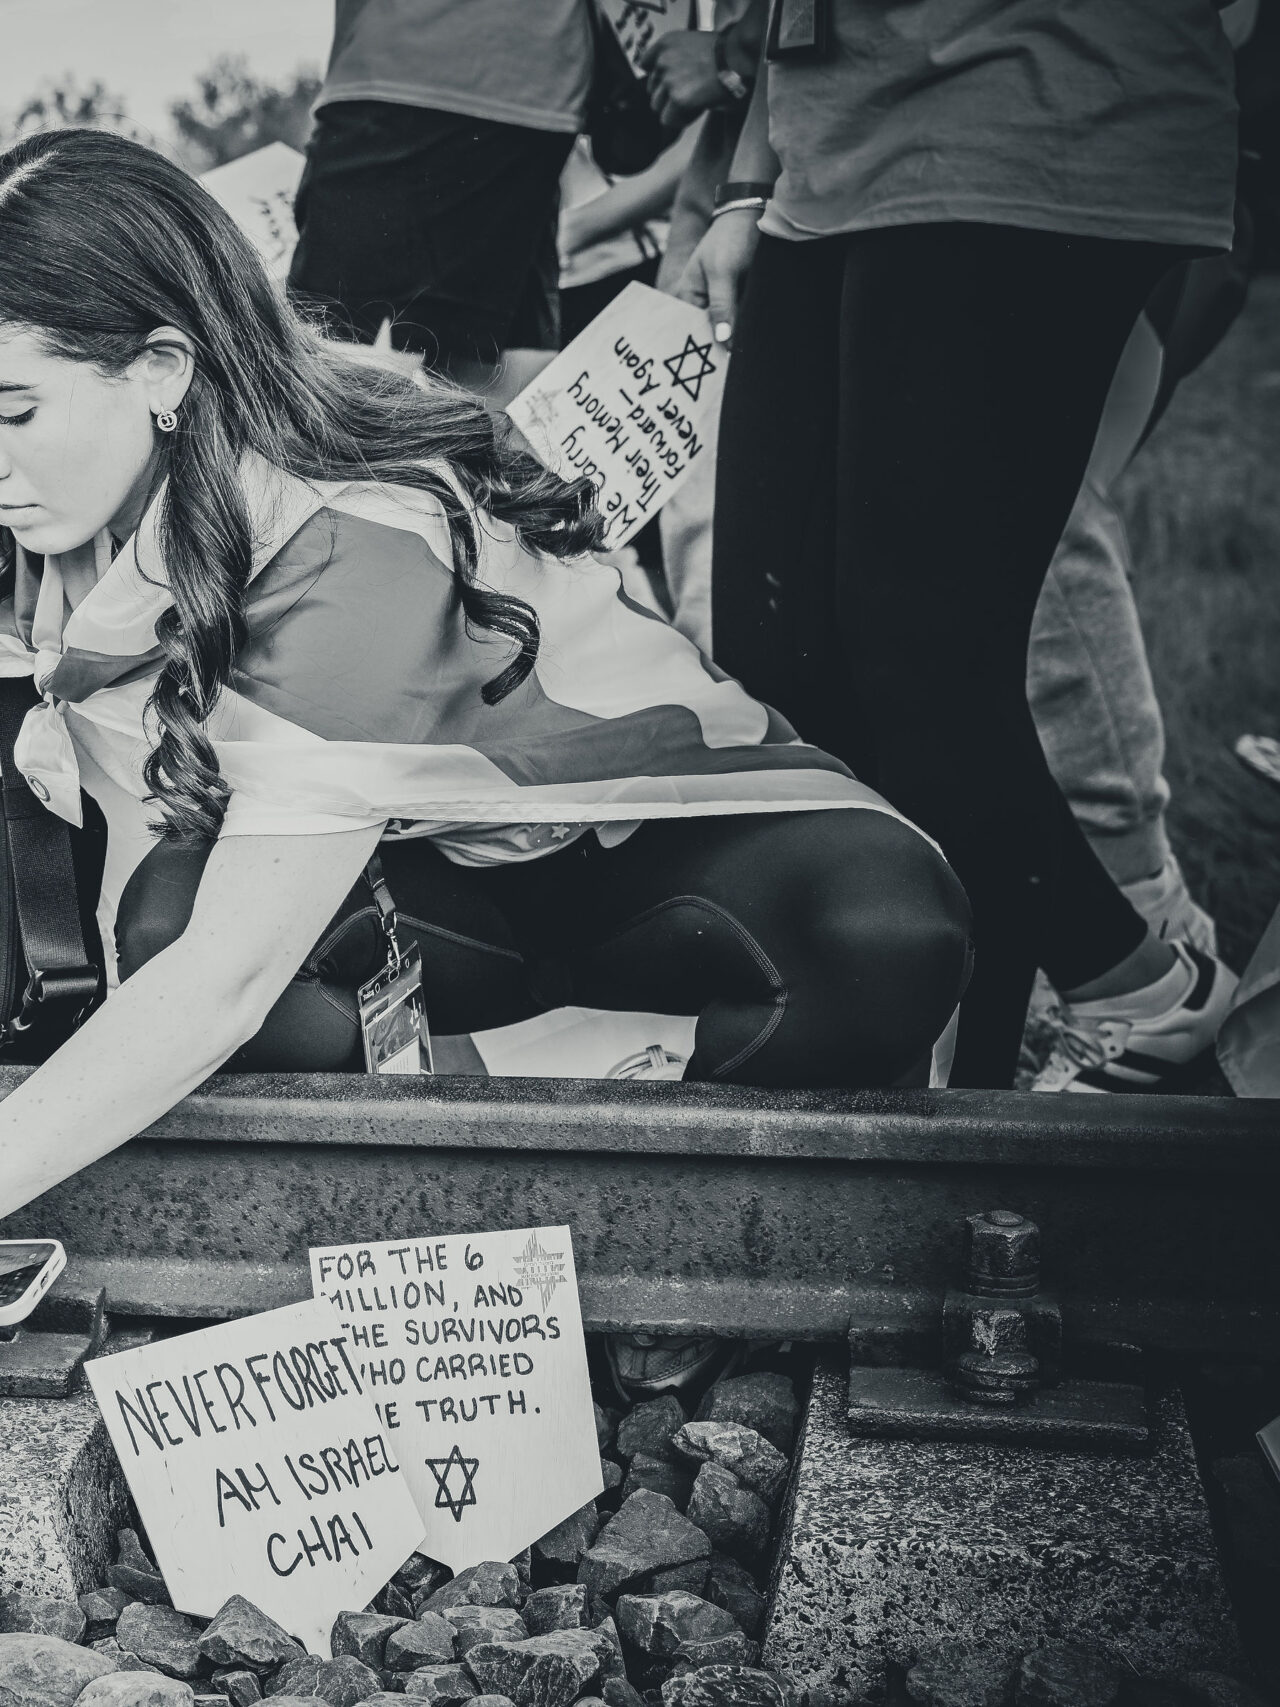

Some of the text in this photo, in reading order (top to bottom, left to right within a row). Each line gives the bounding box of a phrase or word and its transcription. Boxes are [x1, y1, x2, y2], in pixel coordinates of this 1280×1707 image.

[613, 336, 704, 460] Never Again
[567, 371, 662, 512] Their Memory
[603, 491, 638, 540] We
[318, 1243, 485, 1283] FOR THE 6
[473, 1284, 524, 1309] AND
[404, 1313, 561, 1346] SURVIVORS
[360, 1351, 534, 1386] HO CARRIED
[115, 1336, 363, 1456] NEVER FORGET
[415, 1389, 541, 1423] TRUTH.
[284, 1434, 400, 1501] ISRAEL
[266, 1511, 373, 1577] CHAI
